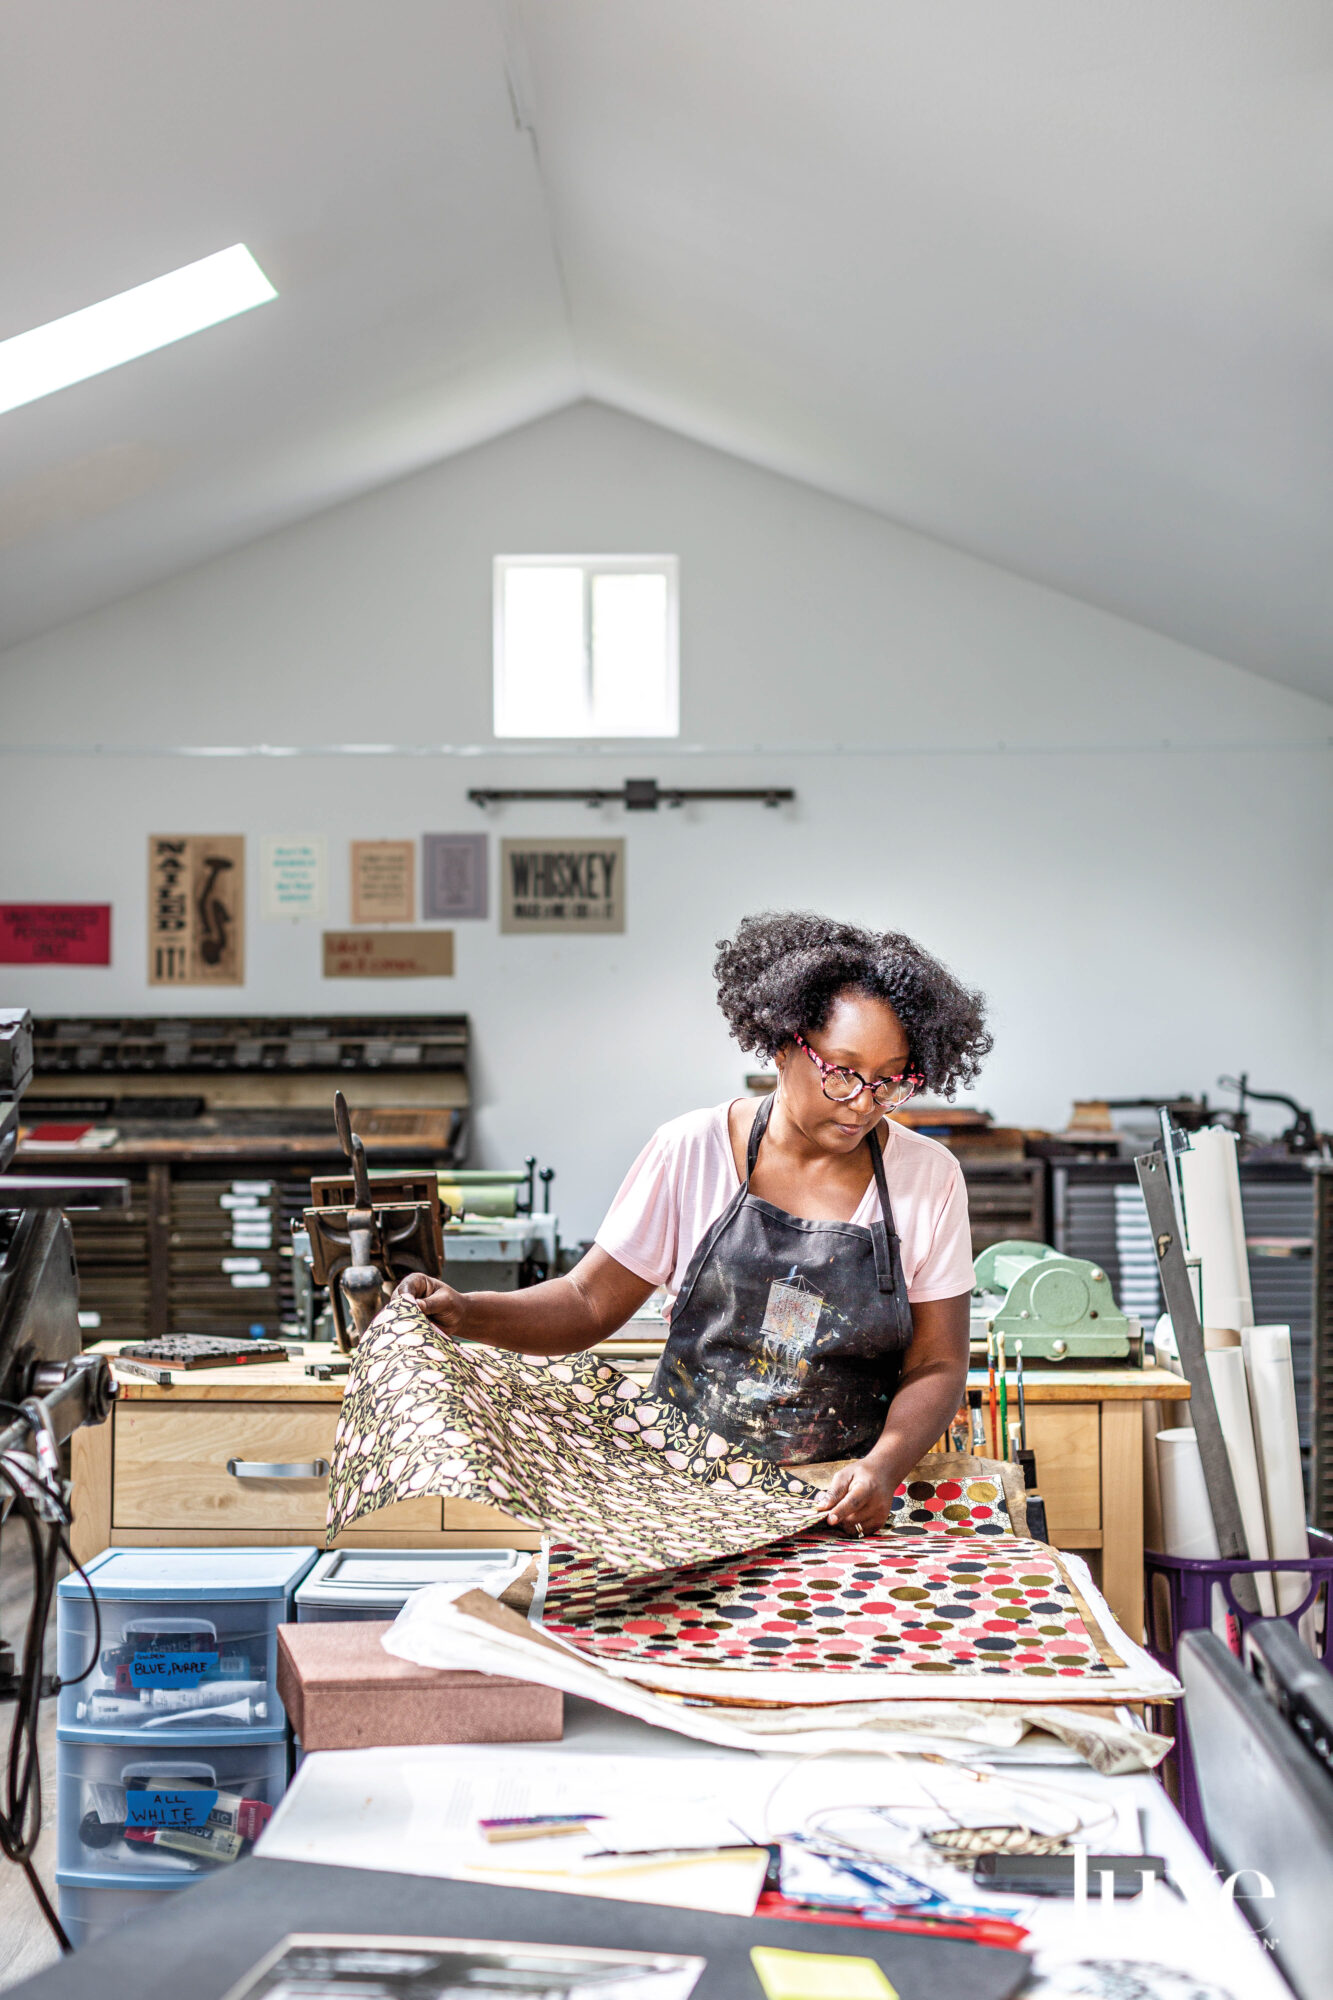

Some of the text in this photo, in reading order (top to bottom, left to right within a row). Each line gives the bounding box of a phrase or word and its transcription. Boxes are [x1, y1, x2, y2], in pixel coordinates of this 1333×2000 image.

[509, 851, 617, 899] WHISKEY
[156, 946, 186, 979] IT!
[153, 1794, 186, 1804] ALL
[131, 1807, 197, 1822] WHITE
